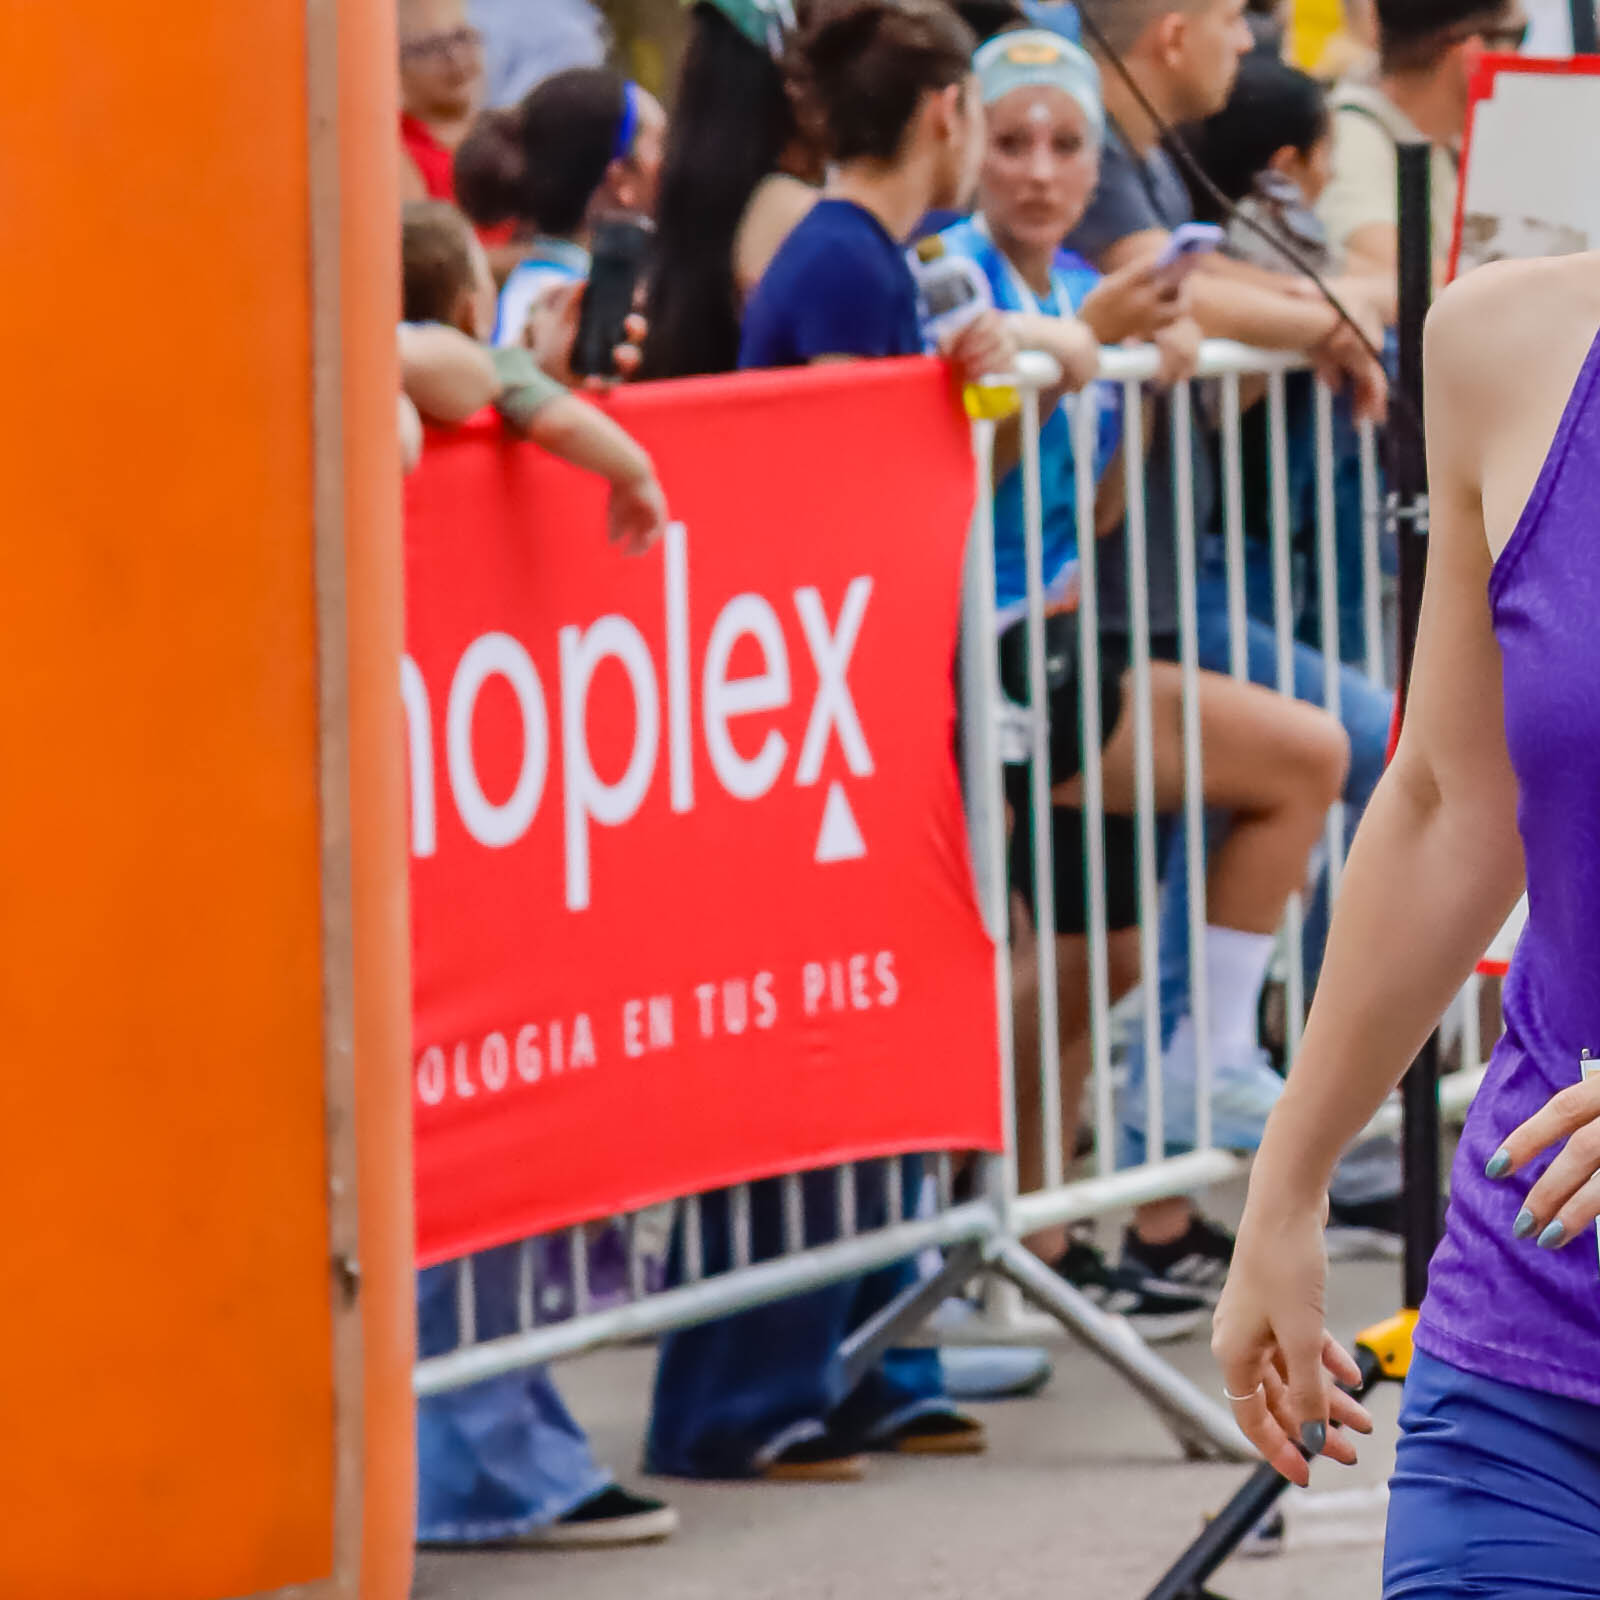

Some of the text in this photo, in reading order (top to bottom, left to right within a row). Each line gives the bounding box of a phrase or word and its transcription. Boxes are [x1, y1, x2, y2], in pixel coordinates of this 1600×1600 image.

[416, 950, 900, 1106] OLOGIA EN TUS PIES
